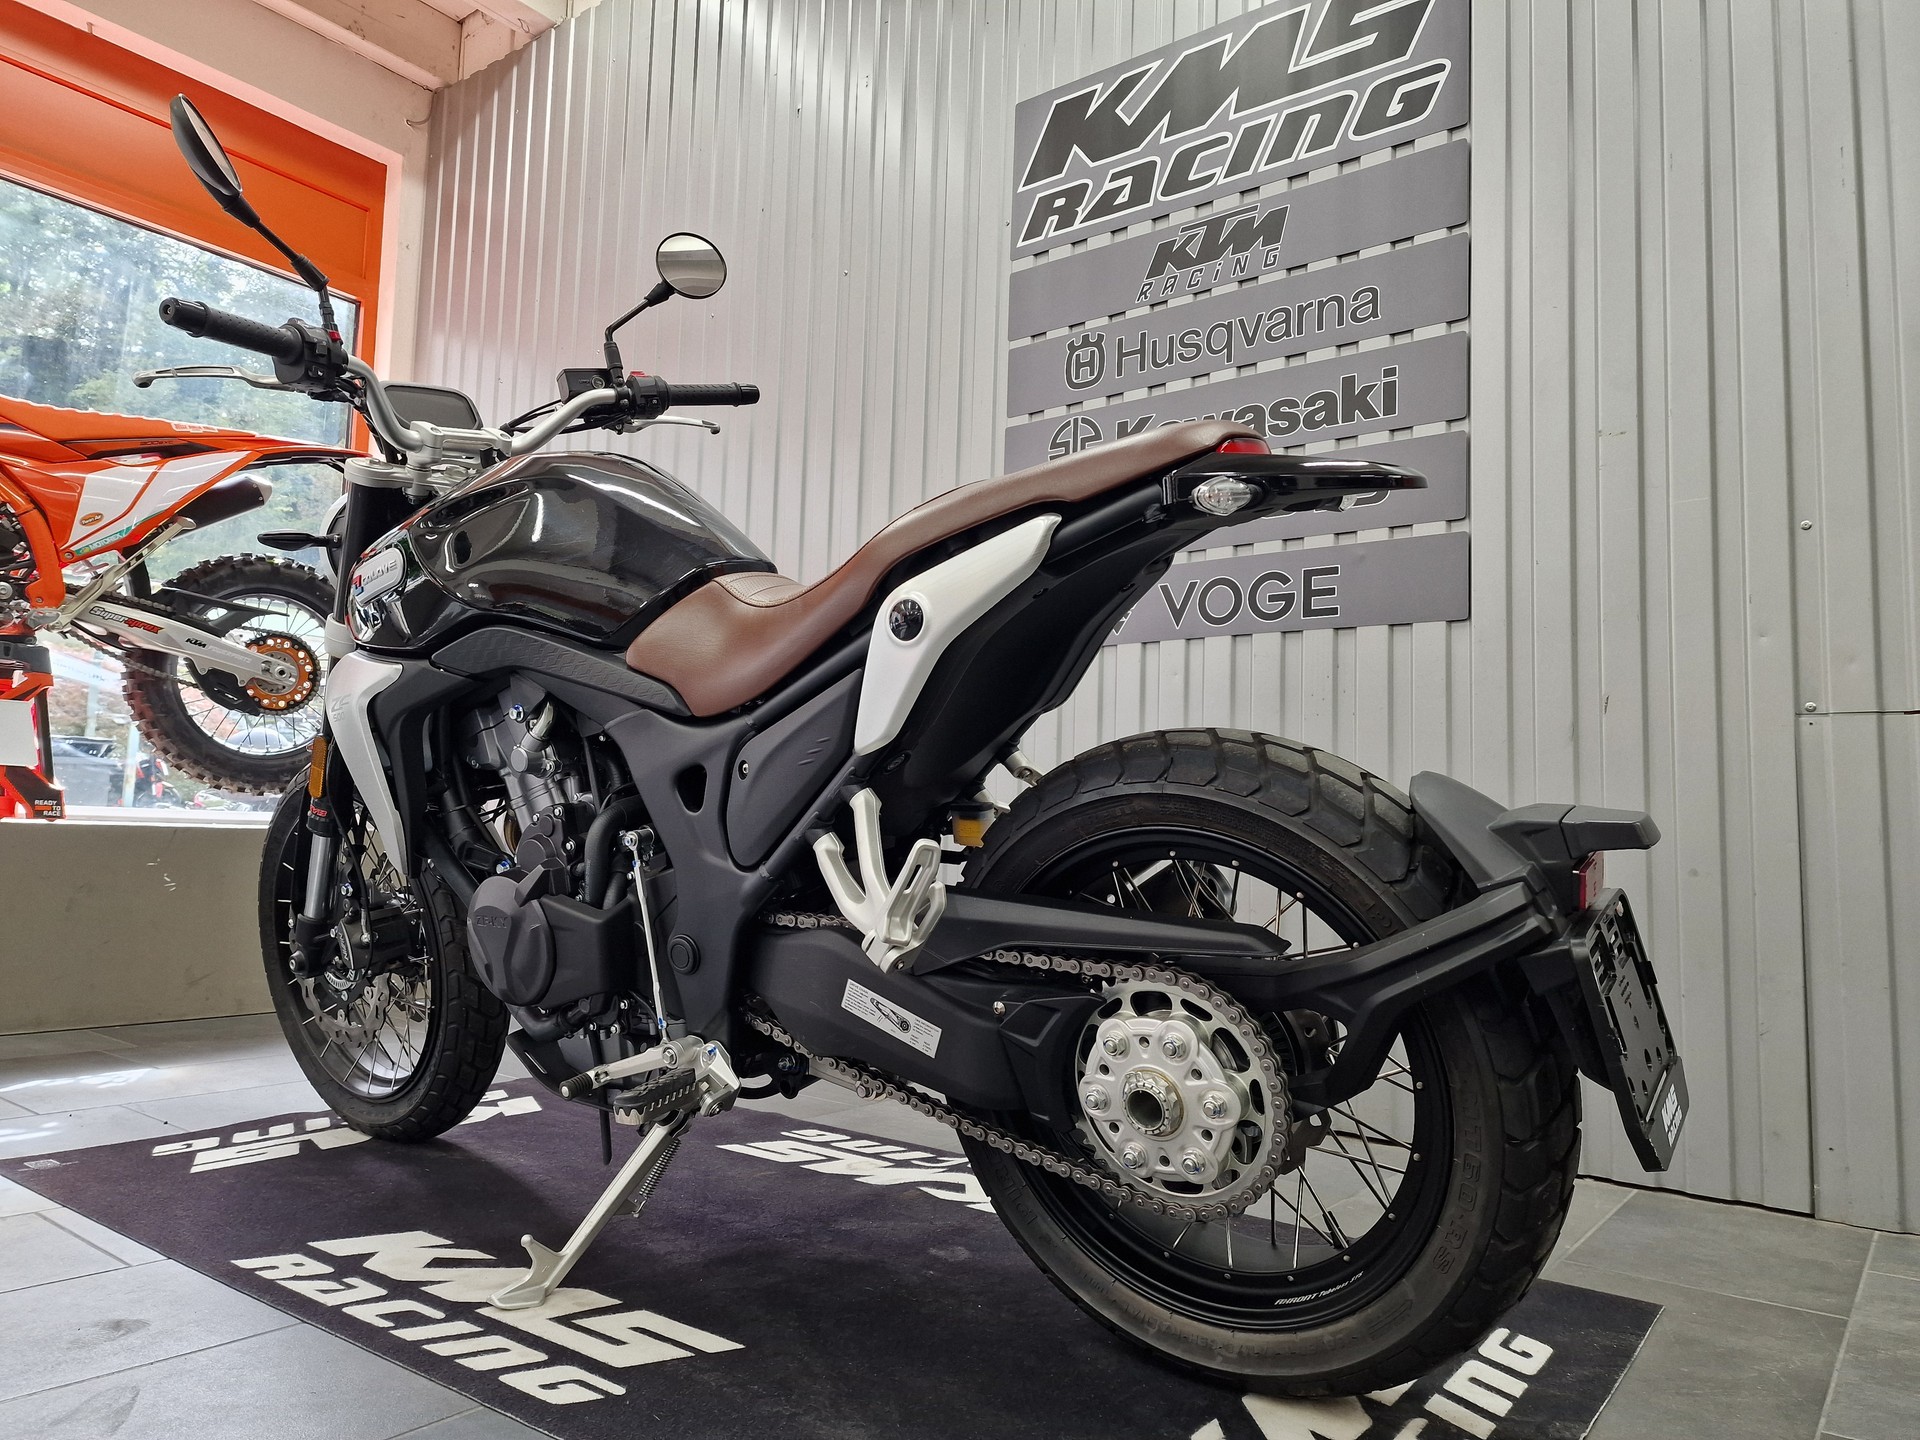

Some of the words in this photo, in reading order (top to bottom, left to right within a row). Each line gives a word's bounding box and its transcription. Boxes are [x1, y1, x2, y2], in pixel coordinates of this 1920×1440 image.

[1017, 0, 1435, 193] KMS
[1143, 204, 1290, 281] KTM
[1115, 285, 1381, 378] Husqvarna
[1116, 365, 1398, 440] asaki
[1158, 565, 1341, 630] VOGE
[185, 637, 207, 649] KTM
[307, 1230, 746, 1368] KMS
